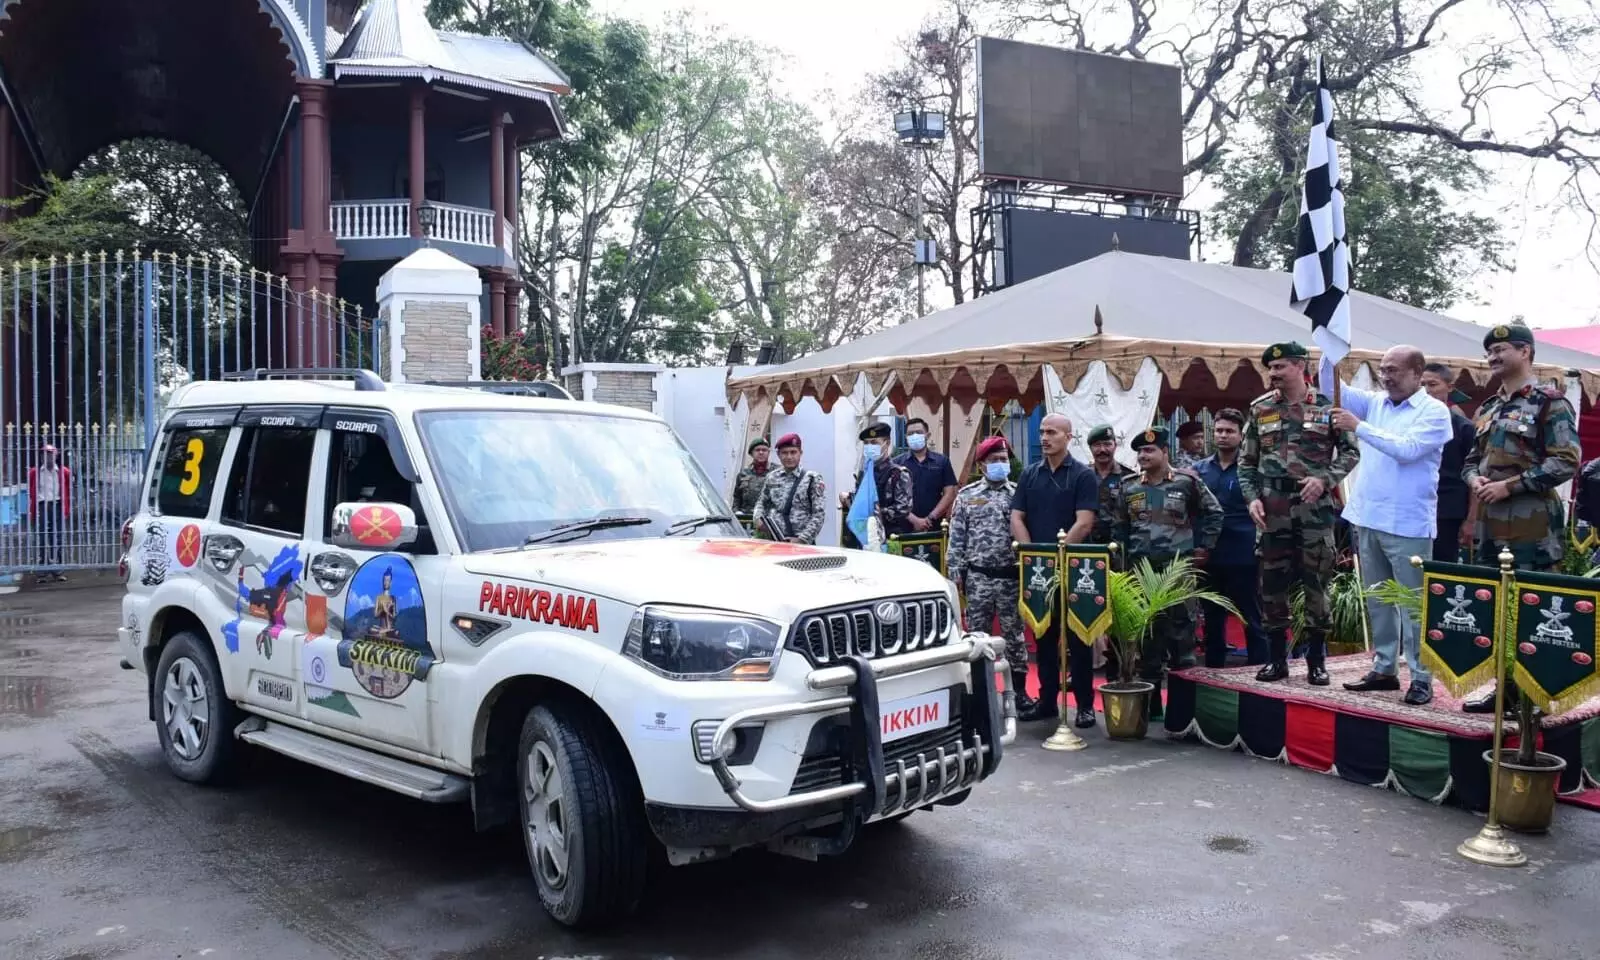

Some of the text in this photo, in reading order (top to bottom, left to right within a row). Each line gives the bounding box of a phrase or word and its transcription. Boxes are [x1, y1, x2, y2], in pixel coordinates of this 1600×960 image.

[186, 418, 215, 427] SCORPIO
[260, 416, 295, 426] SCORPIO
[335, 420, 378, 434] SCORPIO
[179, 437, 204, 496] 3
[479, 580, 599, 634] PARIKRAMA
[349, 640, 422, 675] SIKKIM
[882, 702, 940, 735] IKKIM
